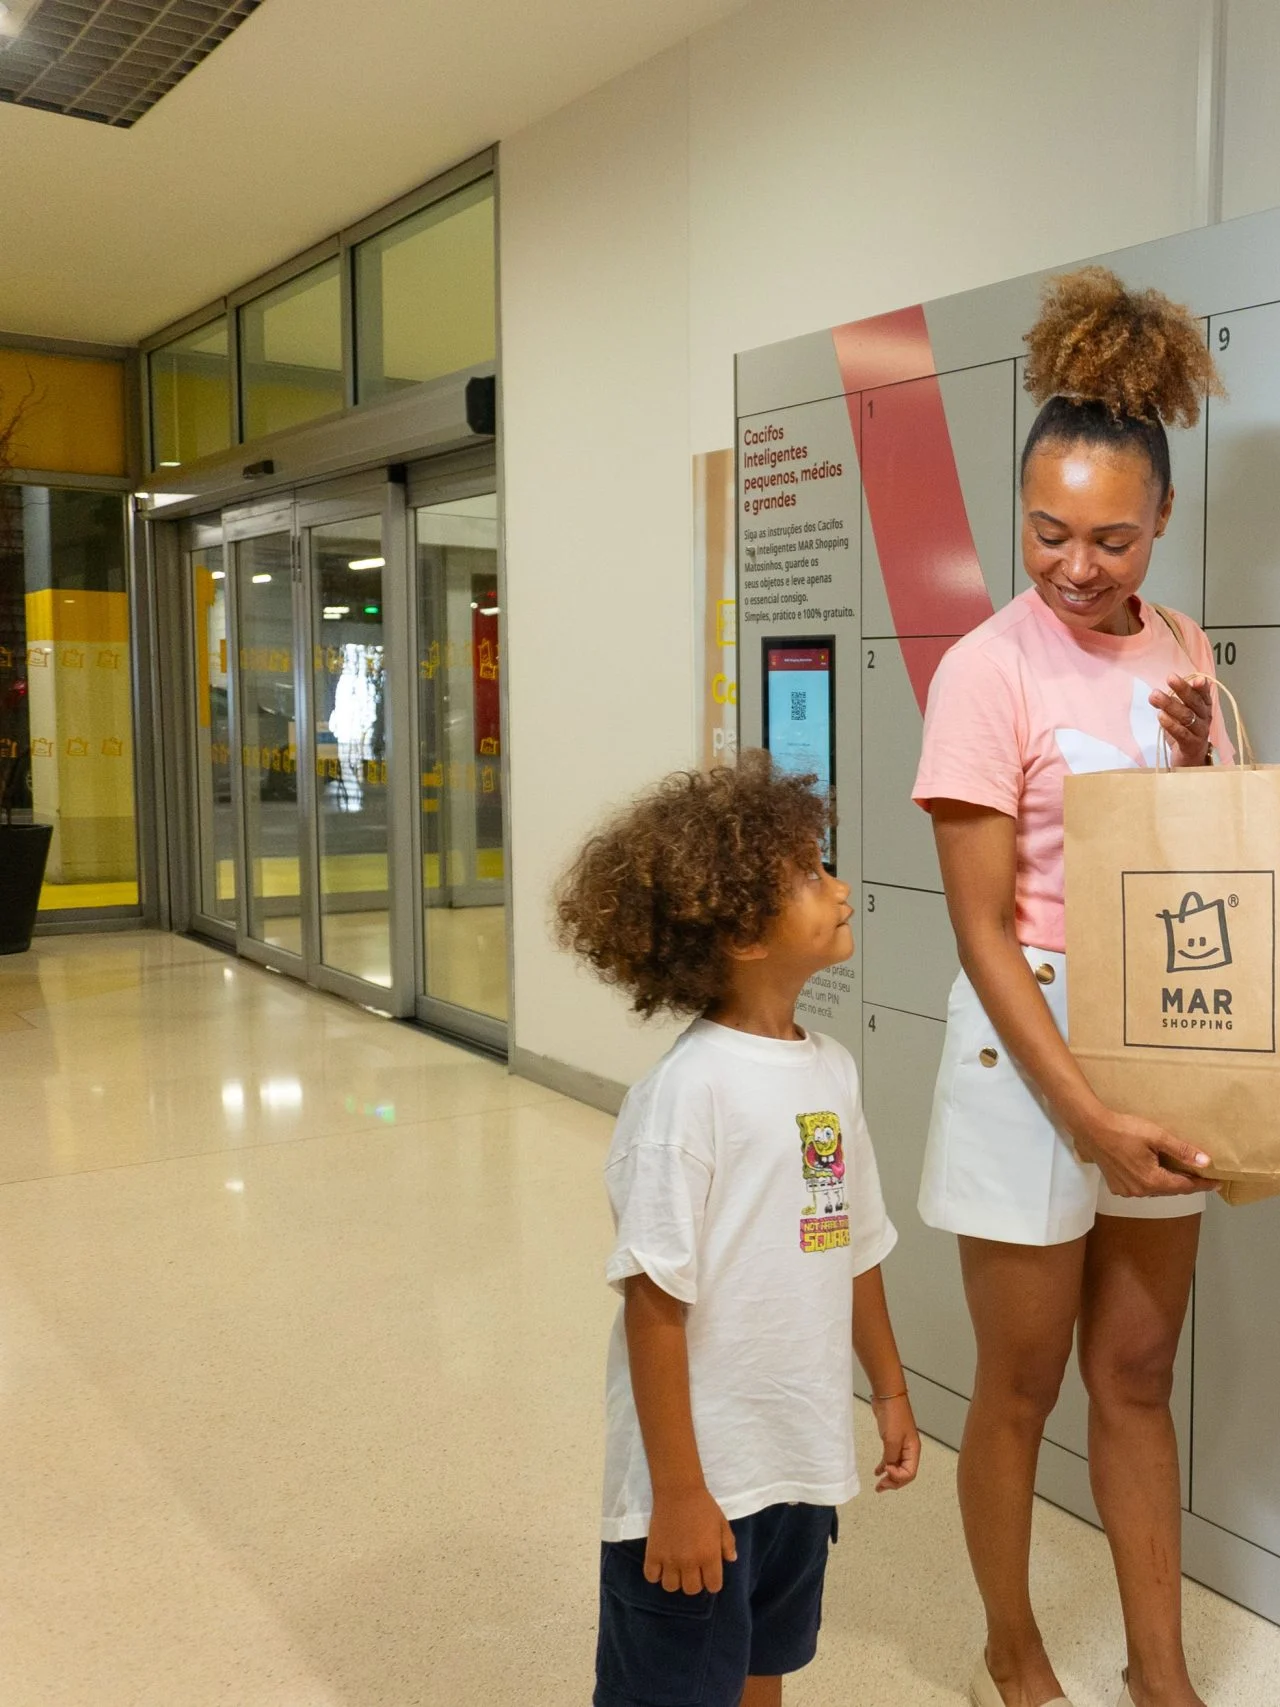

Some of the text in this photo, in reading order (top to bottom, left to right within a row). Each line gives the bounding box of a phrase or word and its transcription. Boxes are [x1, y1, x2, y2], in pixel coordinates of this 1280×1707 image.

[1218, 326, 1231, 352] 9
[867, 400, 874, 418] 1
[744, 424, 784, 446] Cacifos
[744, 445, 808, 468] Inteligentes
[744, 460, 842, 494] pequenos, médios
[744, 491, 797, 516] e grandes
[744, 518, 843, 542] Siga as instruções dos Cacifos
[757, 536, 849, 556] Inteligentes MAR Shopping
[785, 557, 809, 572] guarde
[811, 558, 819, 567] os
[744, 580, 759, 589] seus
[760, 577, 784, 590] objetos
[790, 575, 805, 586] leve
[807, 574, 832, 587] apenas
[750, 593, 779, 605] essencial
[780, 592, 808, 605] consigo.
[772, 609, 796, 623] prático
[803, 608, 821, 619] 100%
[823, 607, 855, 621] gratuito.
[867, 650, 875, 669] 2
[1213, 641, 1237, 666] 10
[867, 894, 875, 913] 3
[839, 982, 850, 993] seu
[1161, 987, 1233, 1015] MAR
[868, 1014, 876, 1032] 4
[1162, 1018, 1233, 1030] SHOPPING
